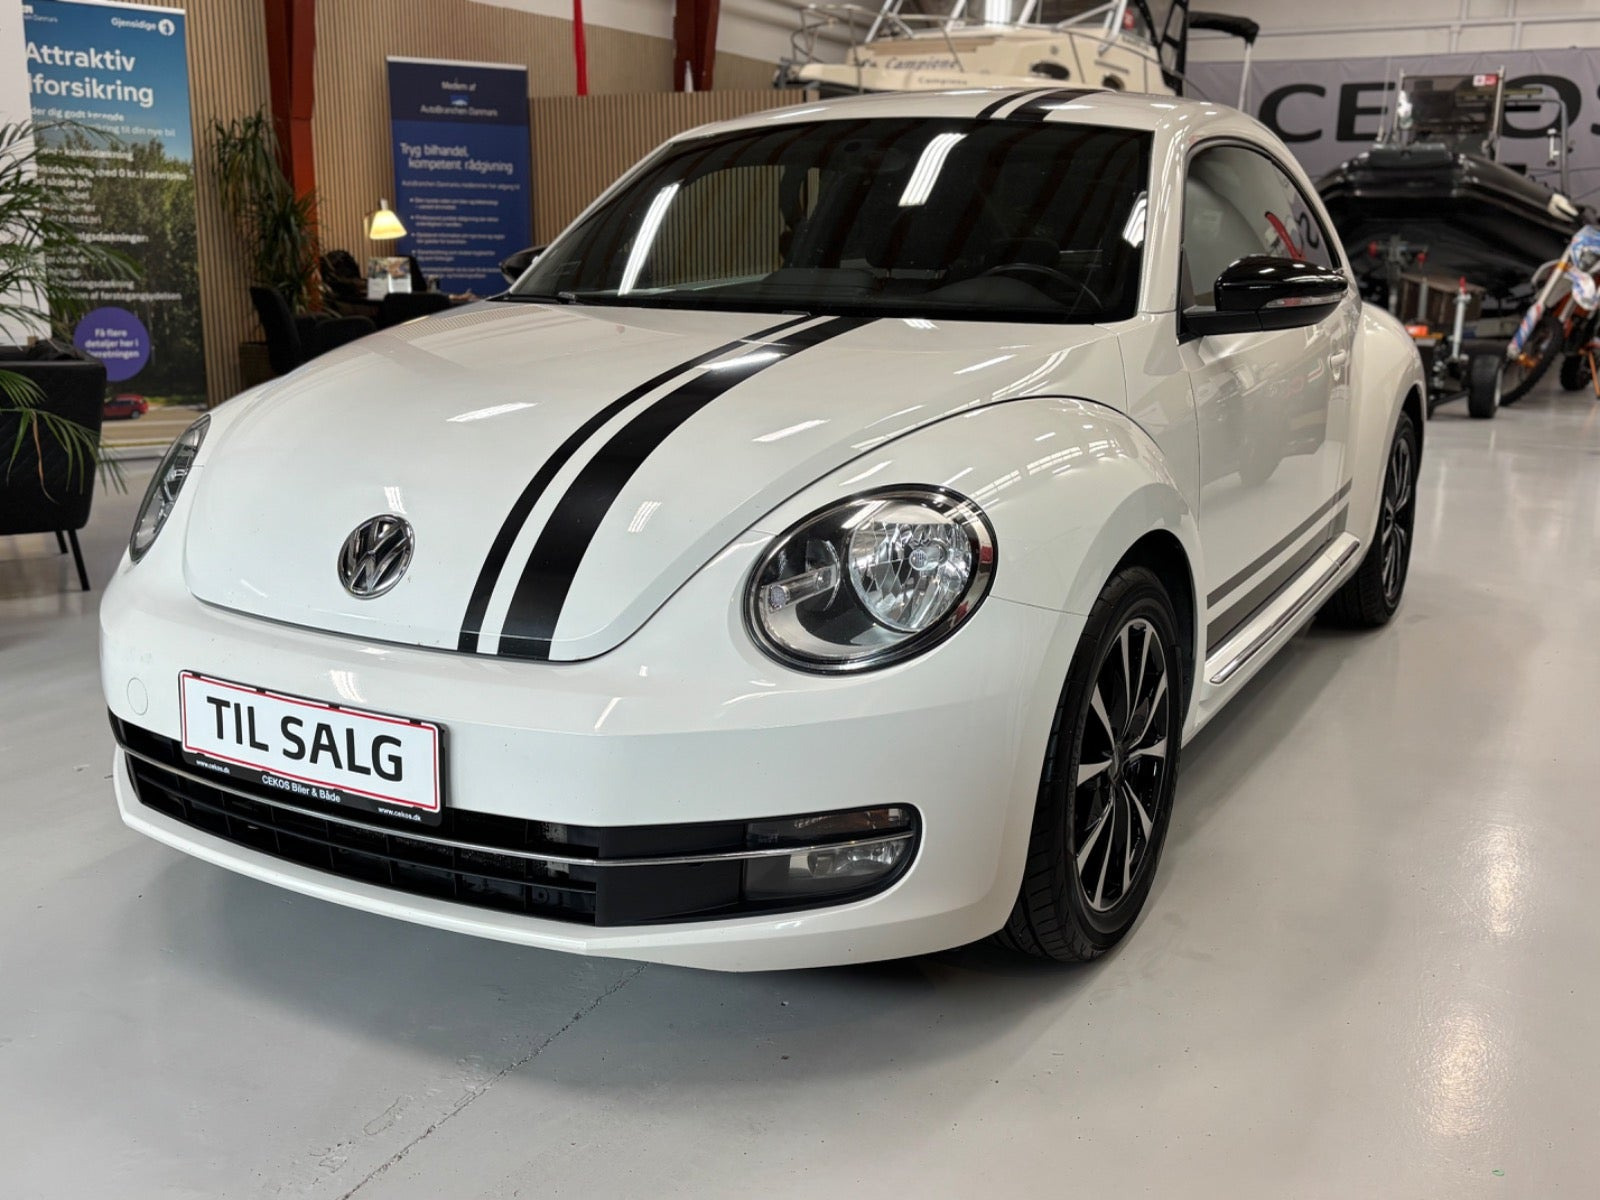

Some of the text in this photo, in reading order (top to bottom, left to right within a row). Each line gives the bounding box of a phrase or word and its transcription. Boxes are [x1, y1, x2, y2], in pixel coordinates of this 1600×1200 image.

[111, 17, 156, 31] Gjensidige
[26, 42, 135, 71] Attraktiv
[29, 73, 154, 108] lforsikring
[64, 109, 86, 119] godt
[400, 142, 421, 158] Tryg
[464, 159, 513, 175] rådgivning
[206, 696, 403, 782] TIL SALG
[196, 759, 231, 775] www.cekos.dk
[262, 775, 341, 803] CEKOS Biler & Både
[377, 806, 422, 823] www.cekos.dk
